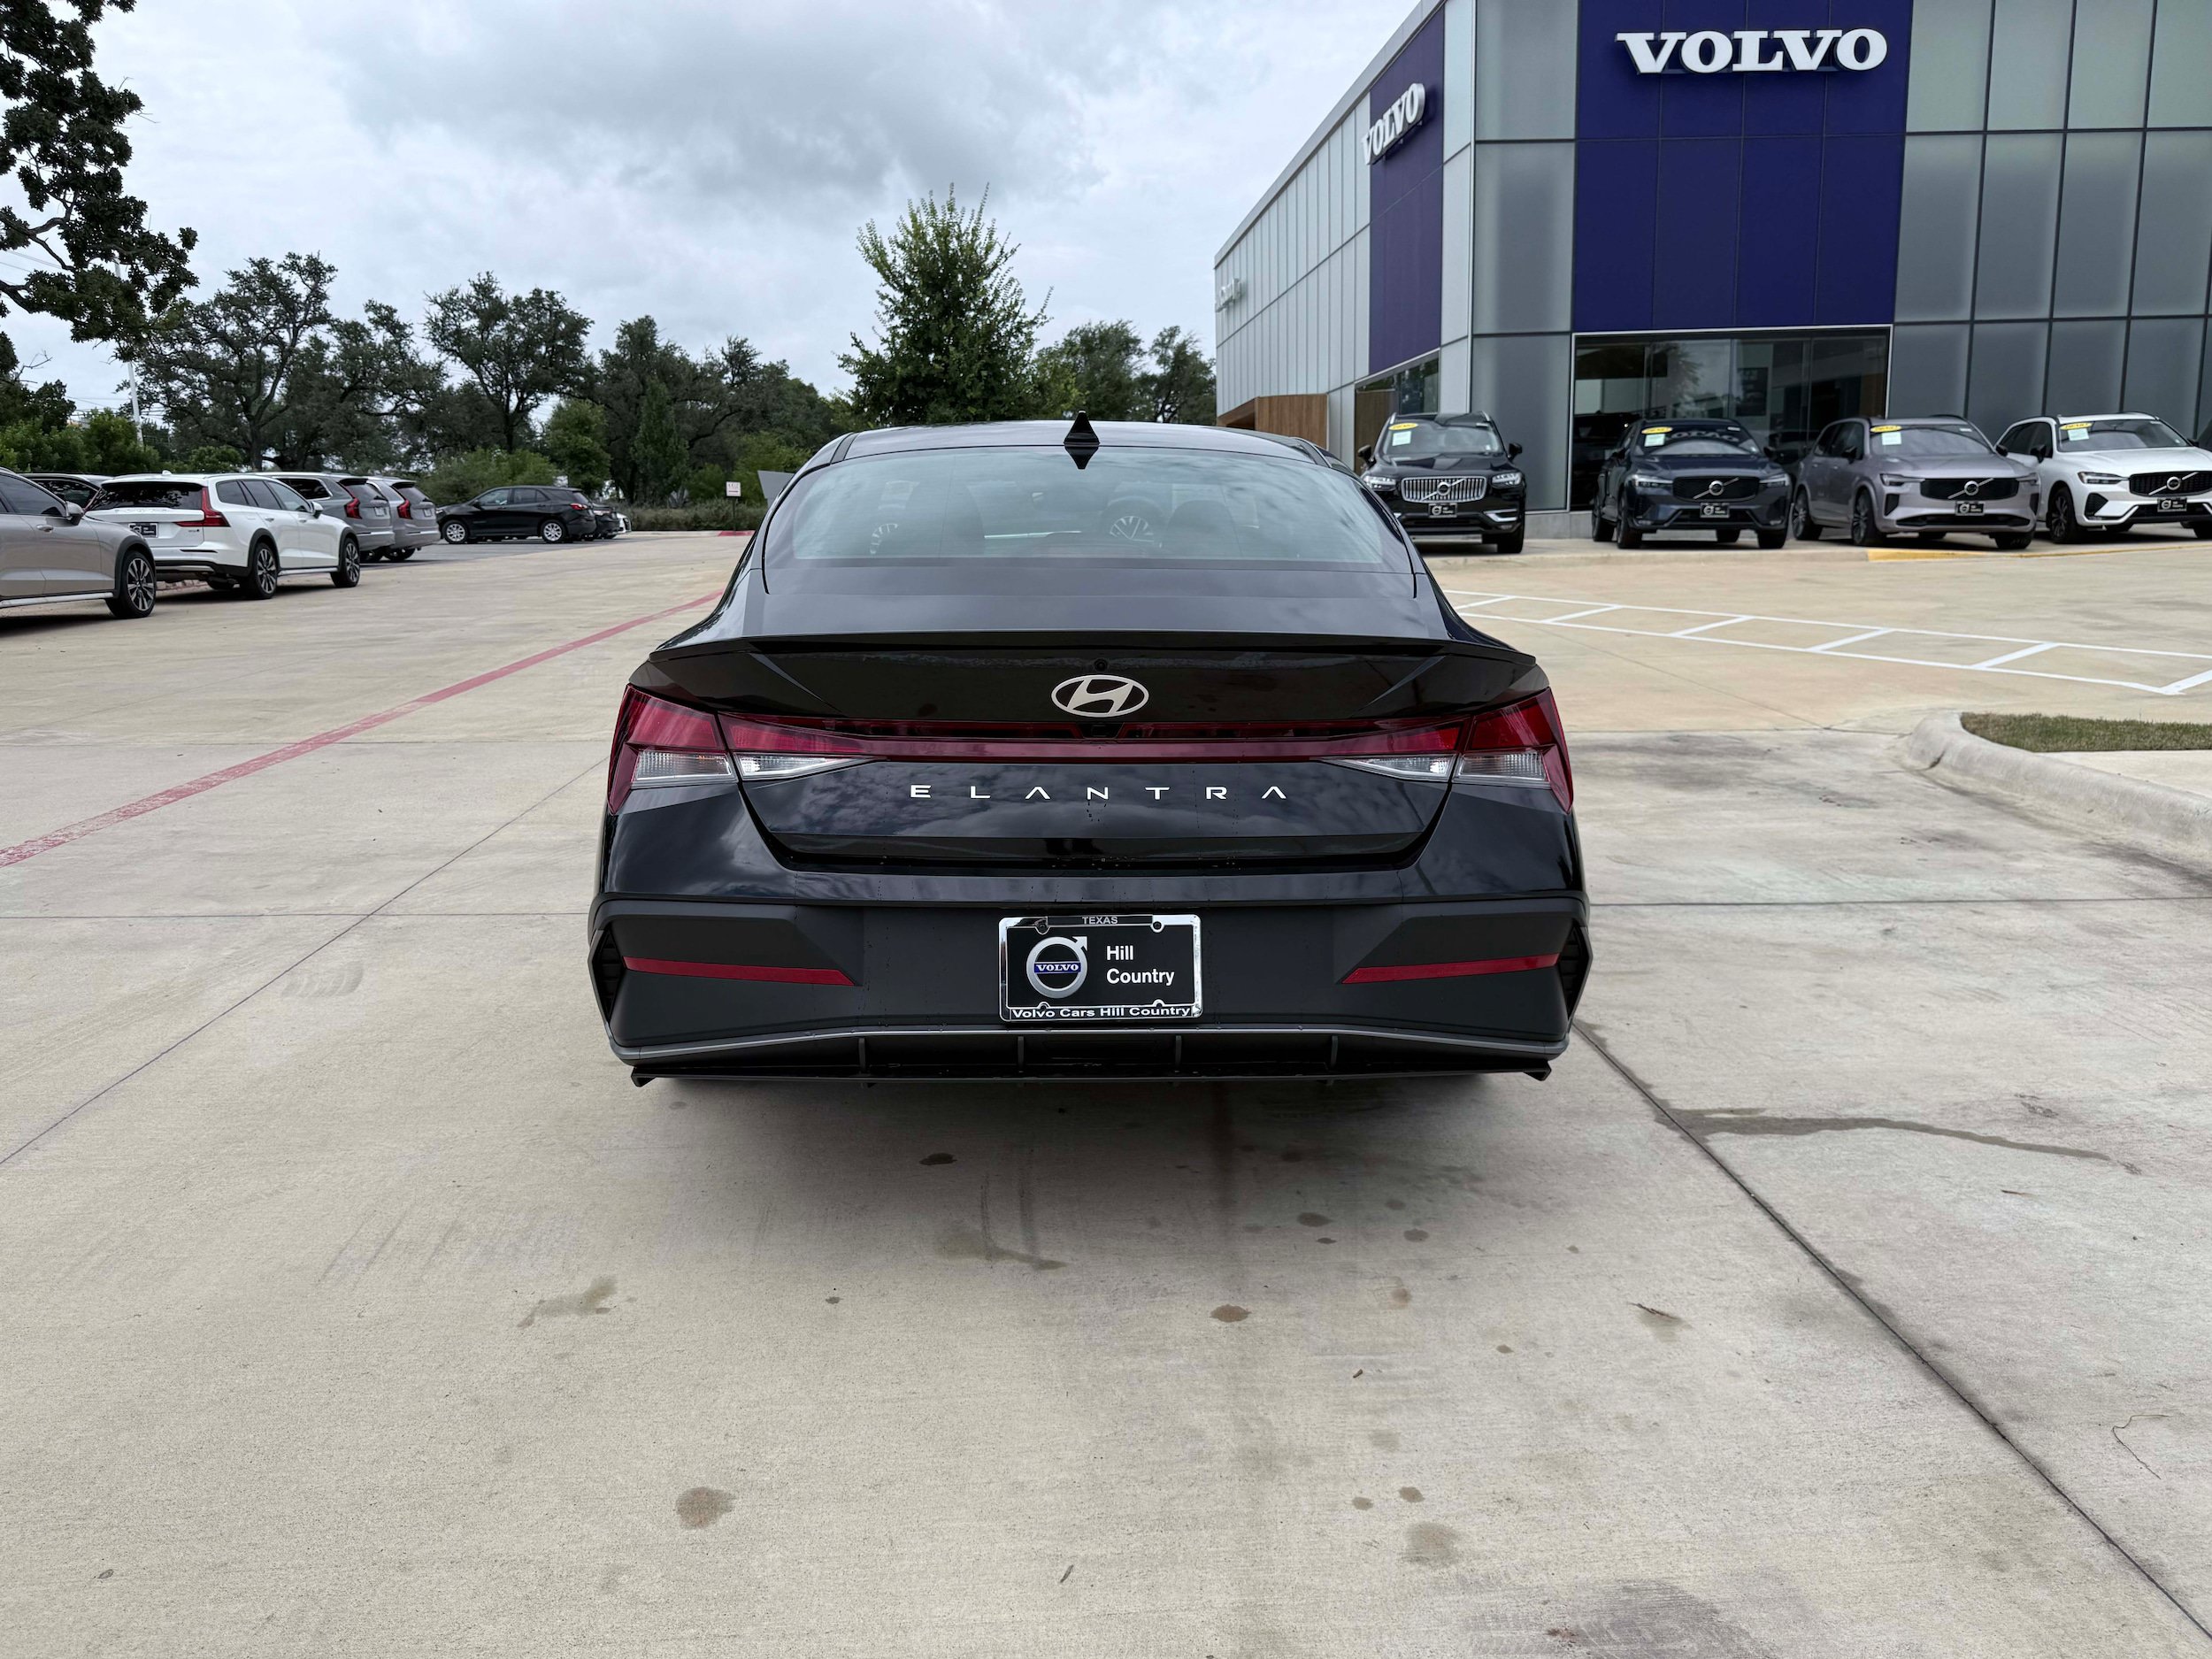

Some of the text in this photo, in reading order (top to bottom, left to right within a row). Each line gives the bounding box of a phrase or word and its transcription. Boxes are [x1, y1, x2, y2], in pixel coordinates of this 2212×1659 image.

[1616, 28, 1887, 73] VOLVO
[1362, 83, 1425, 165] VOLVO
[910, 784, 1286, 800] ELANTRA
[1082, 916, 1118, 925] TEXAS
[1106, 945, 1133, 961] Hill
[1106, 968, 1175, 987] Country
[1012, 1006, 1191, 1018] Volvo Cars Hill Country
